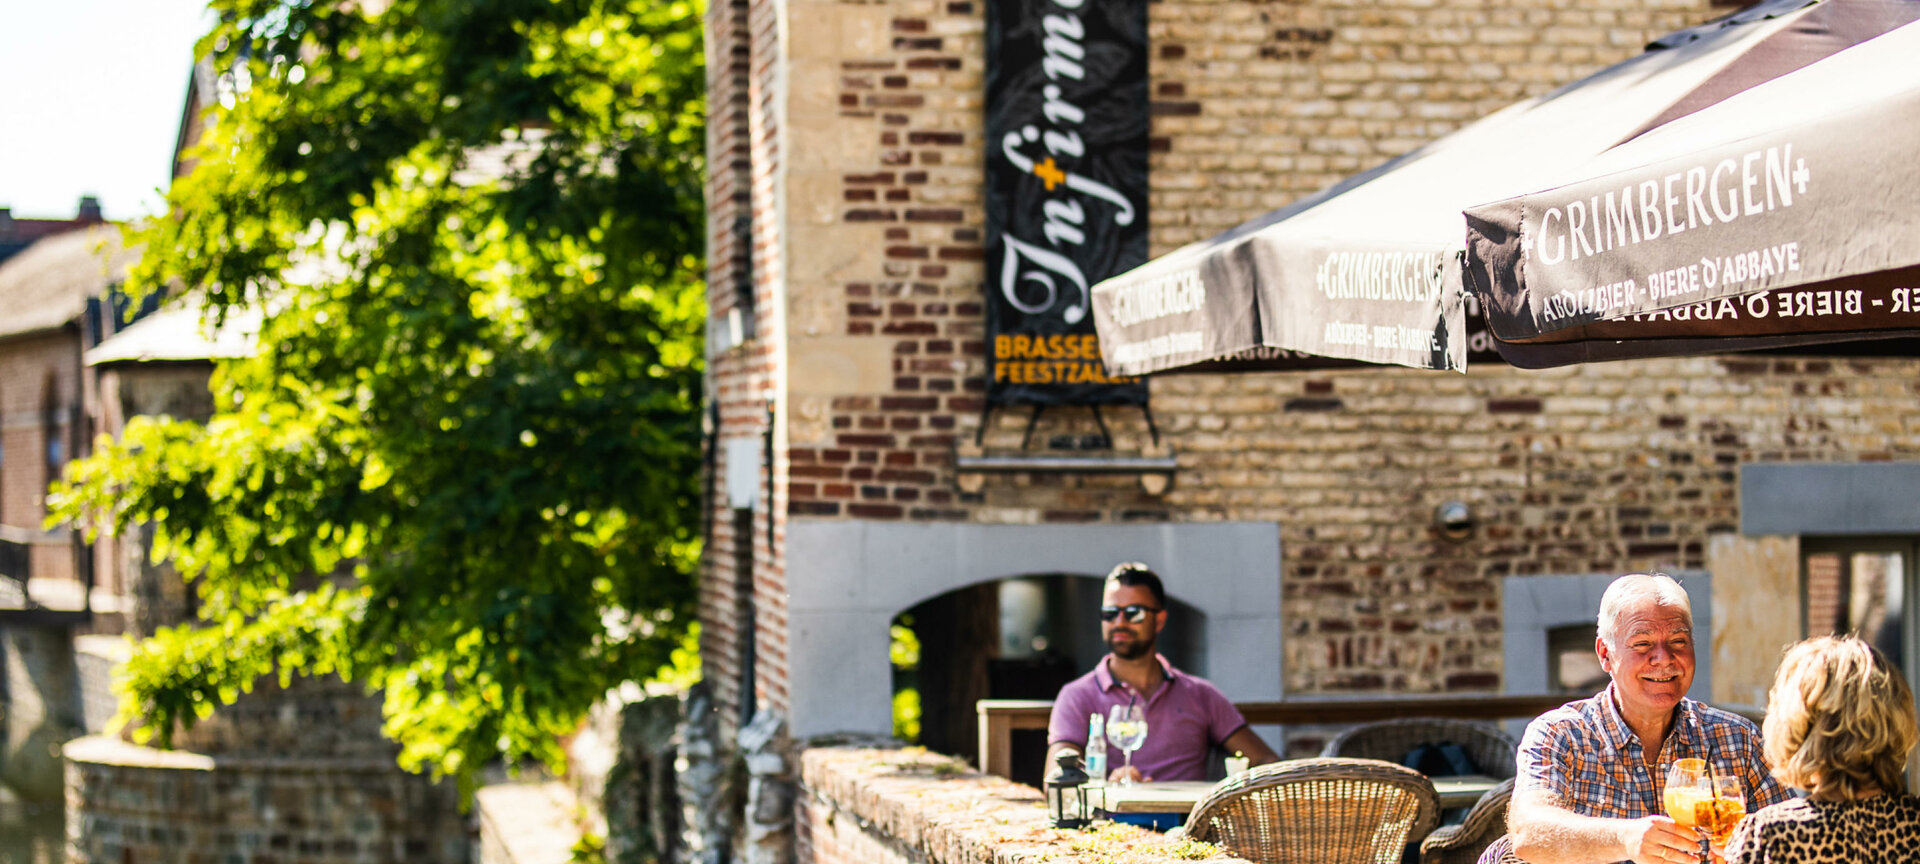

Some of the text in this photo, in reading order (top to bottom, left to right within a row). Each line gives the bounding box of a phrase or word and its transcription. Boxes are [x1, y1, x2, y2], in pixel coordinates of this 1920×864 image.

[1537, 144, 1794, 266] GRIMBERGEN
[1324, 252, 1439, 302] GRIMBERGEN
[1648, 264, 1699, 300] BIERE
[1701, 242, 1799, 288] D'ABBAYE
[995, 334, 1102, 359] BRASSE
[995, 362, 1142, 383] FEESTZAL
